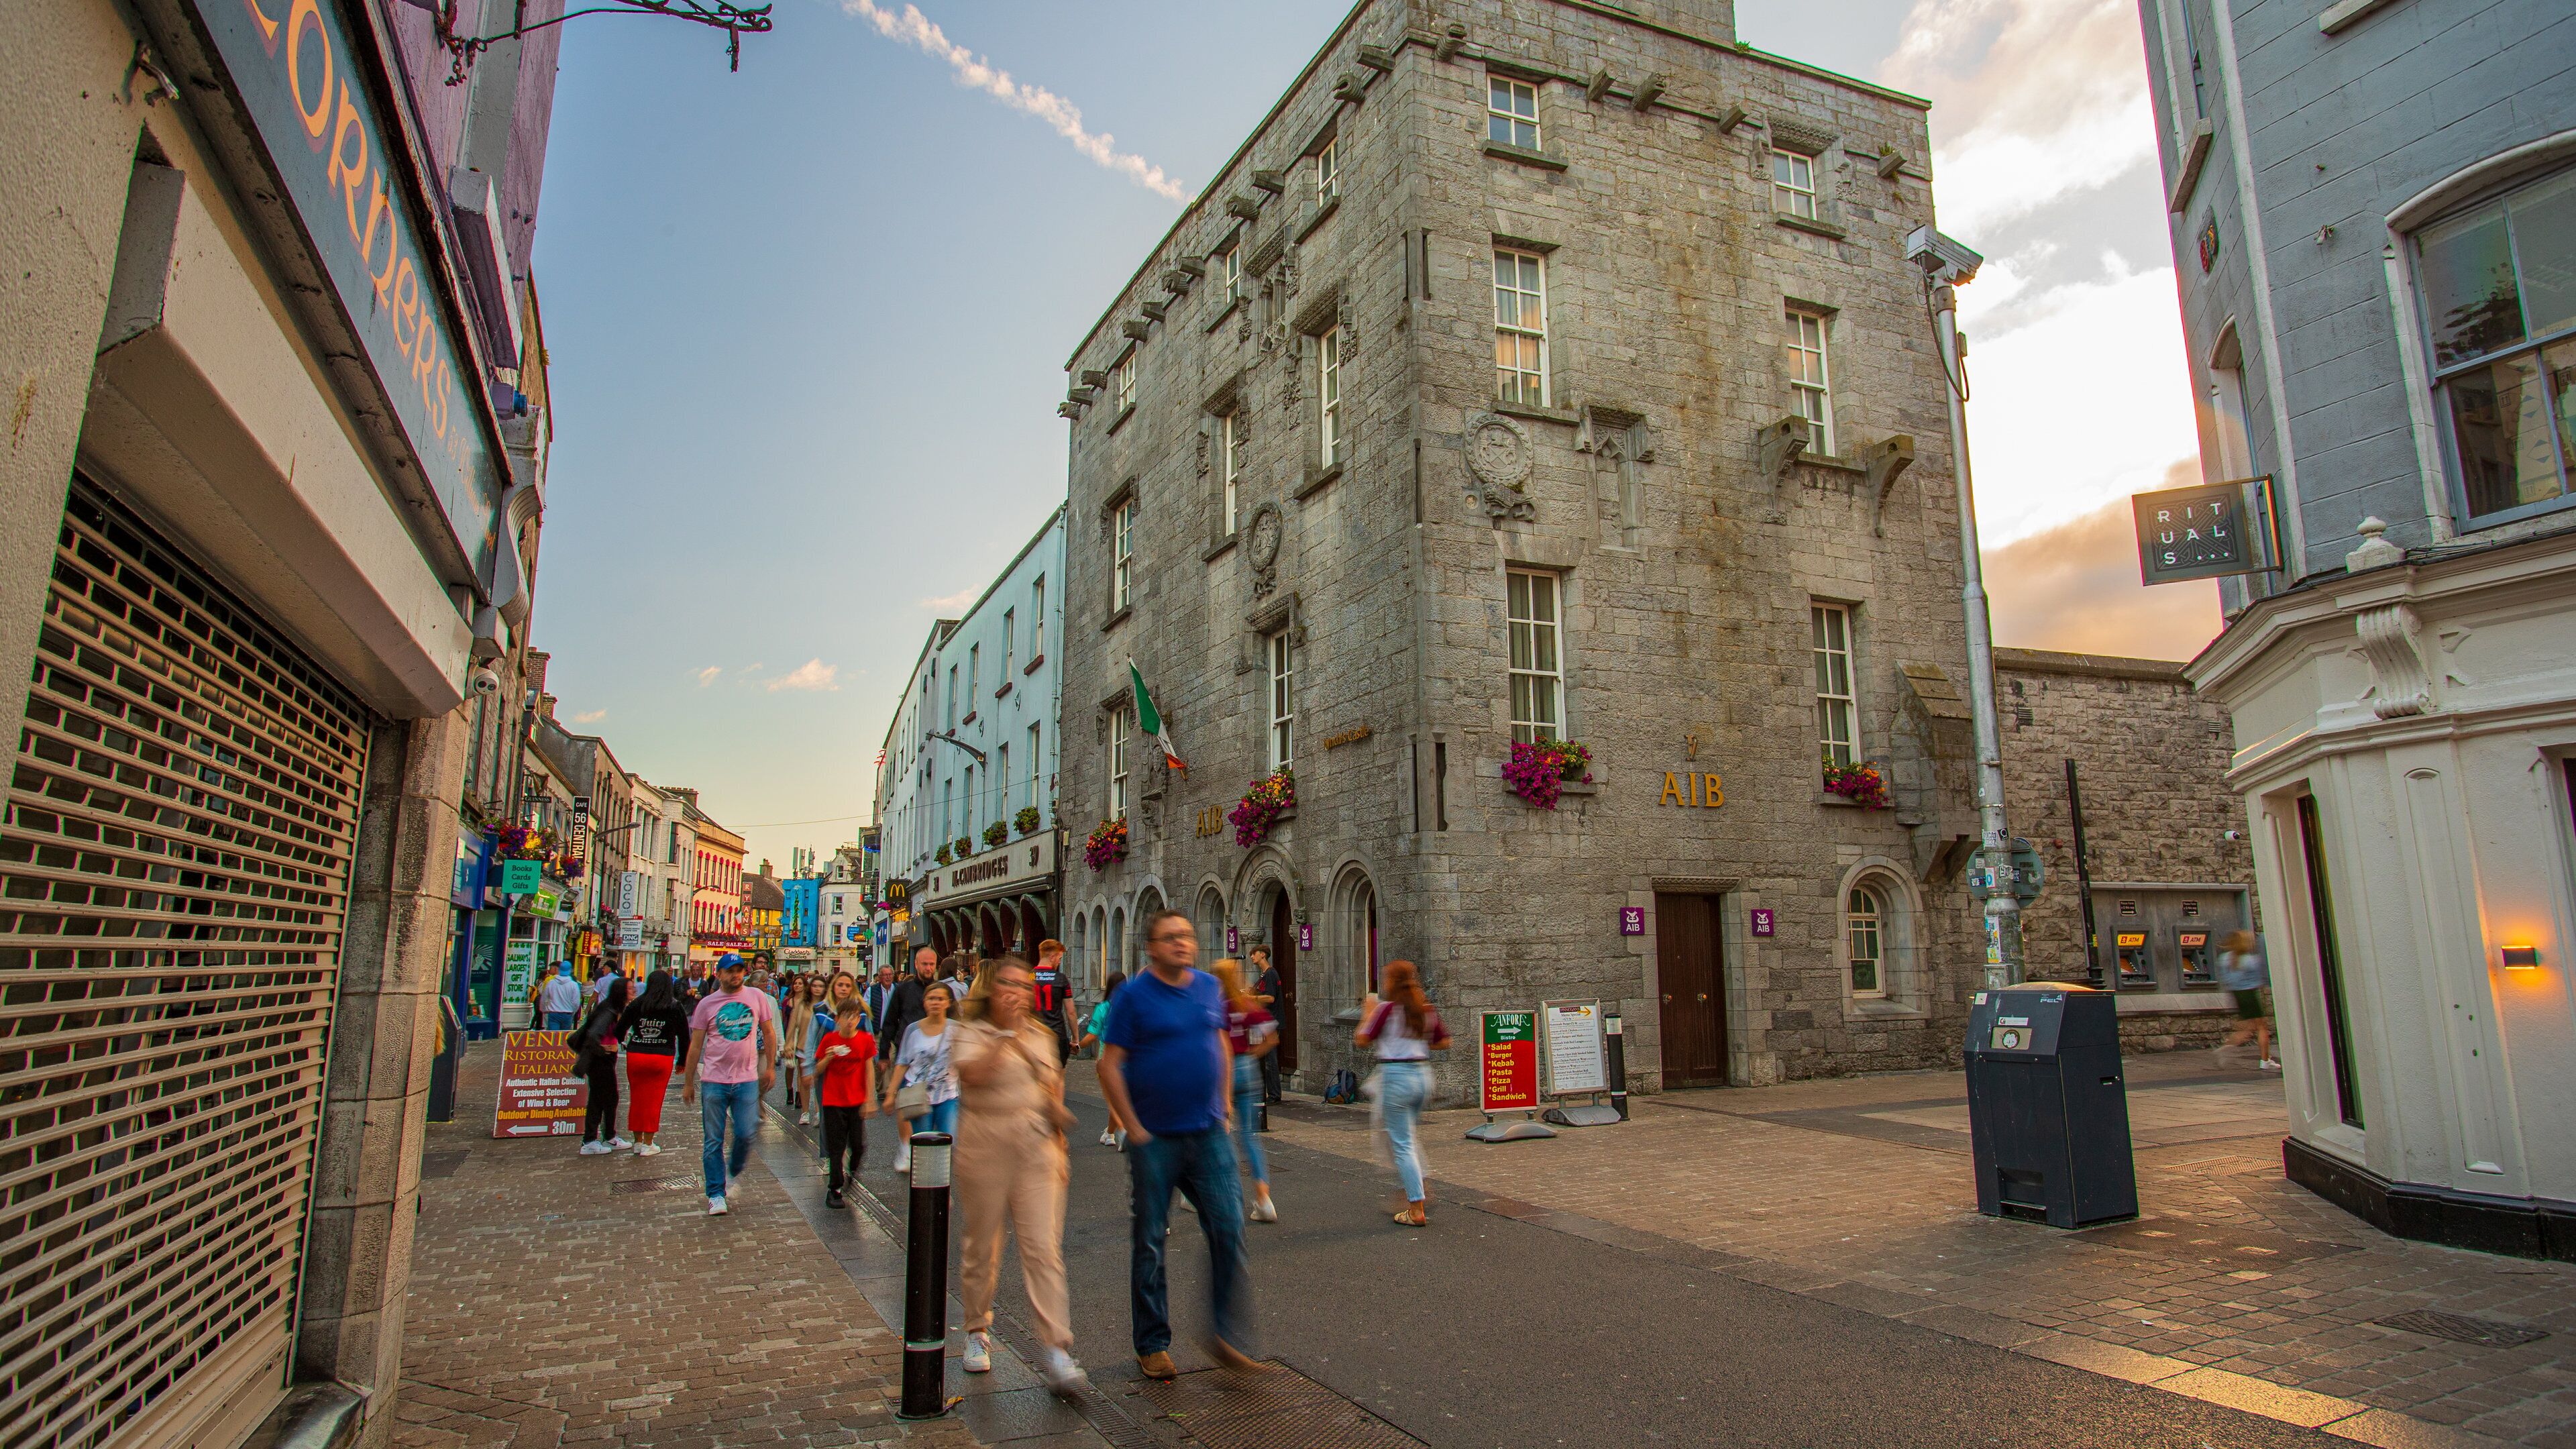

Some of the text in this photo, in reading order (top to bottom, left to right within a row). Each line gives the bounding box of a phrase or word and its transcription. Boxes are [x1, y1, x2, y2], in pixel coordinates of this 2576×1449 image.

[1659, 771, 1725, 807] AIB
[575, 812, 586, 823] 56
[1196, 805, 1223, 837] AIB
[622, 875, 633, 910] COCO
[1626, 924, 1640, 932] AIB
[507, 983, 523, 991] STORE
[639, 1018, 666, 1028] Juicy
[1491, 1014, 1530, 1026] ANFORA
[508, 1031, 576, 1047] VENI
[504, 1050, 577, 1061] RISTORAN
[561, 1077, 586, 1085] Cuisine
[513, 1087, 577, 1097] Extensive Selection
[518, 1098, 570, 1108] of Wine & Beer
[497, 1108, 587, 1120] Outdoor Dining Available
[552, 1121, 576, 1134] 30m
